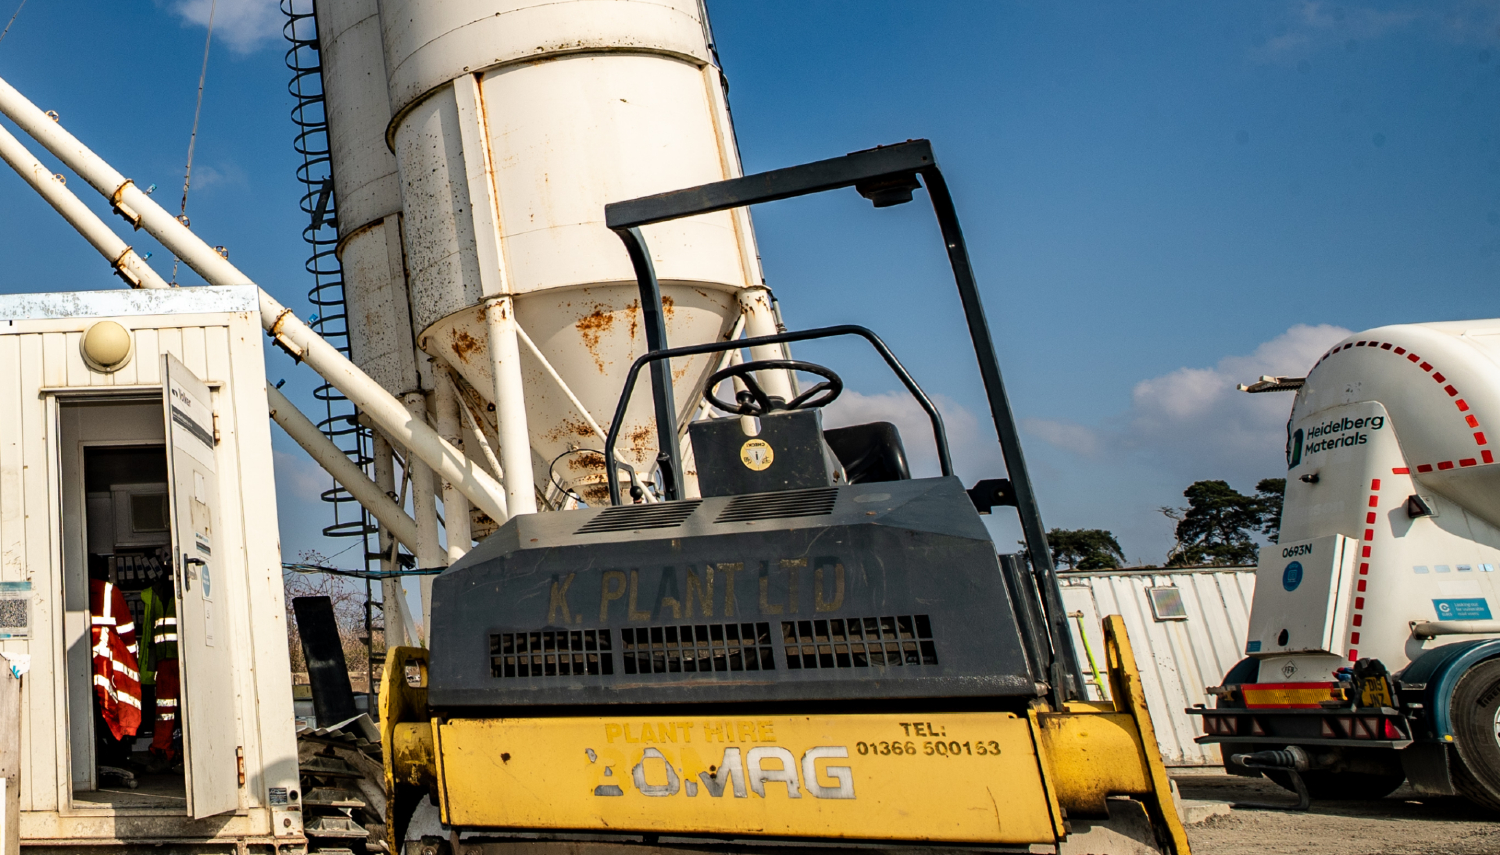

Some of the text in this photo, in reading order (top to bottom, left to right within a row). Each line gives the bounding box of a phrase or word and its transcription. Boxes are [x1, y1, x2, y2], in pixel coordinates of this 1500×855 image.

[1307, 416, 1384, 440] Heidelberg
[1305, 432, 1368, 456] Materials
[1282, 543, 1312, 558] 0693N
[599, 561, 744, 622] PLANT
[758, 555, 845, 616] LTD
[604, 720, 777, 743] PLANT HIRE
[899, 722, 946, 737] TEL:
[856, 740, 917, 756] 01366
